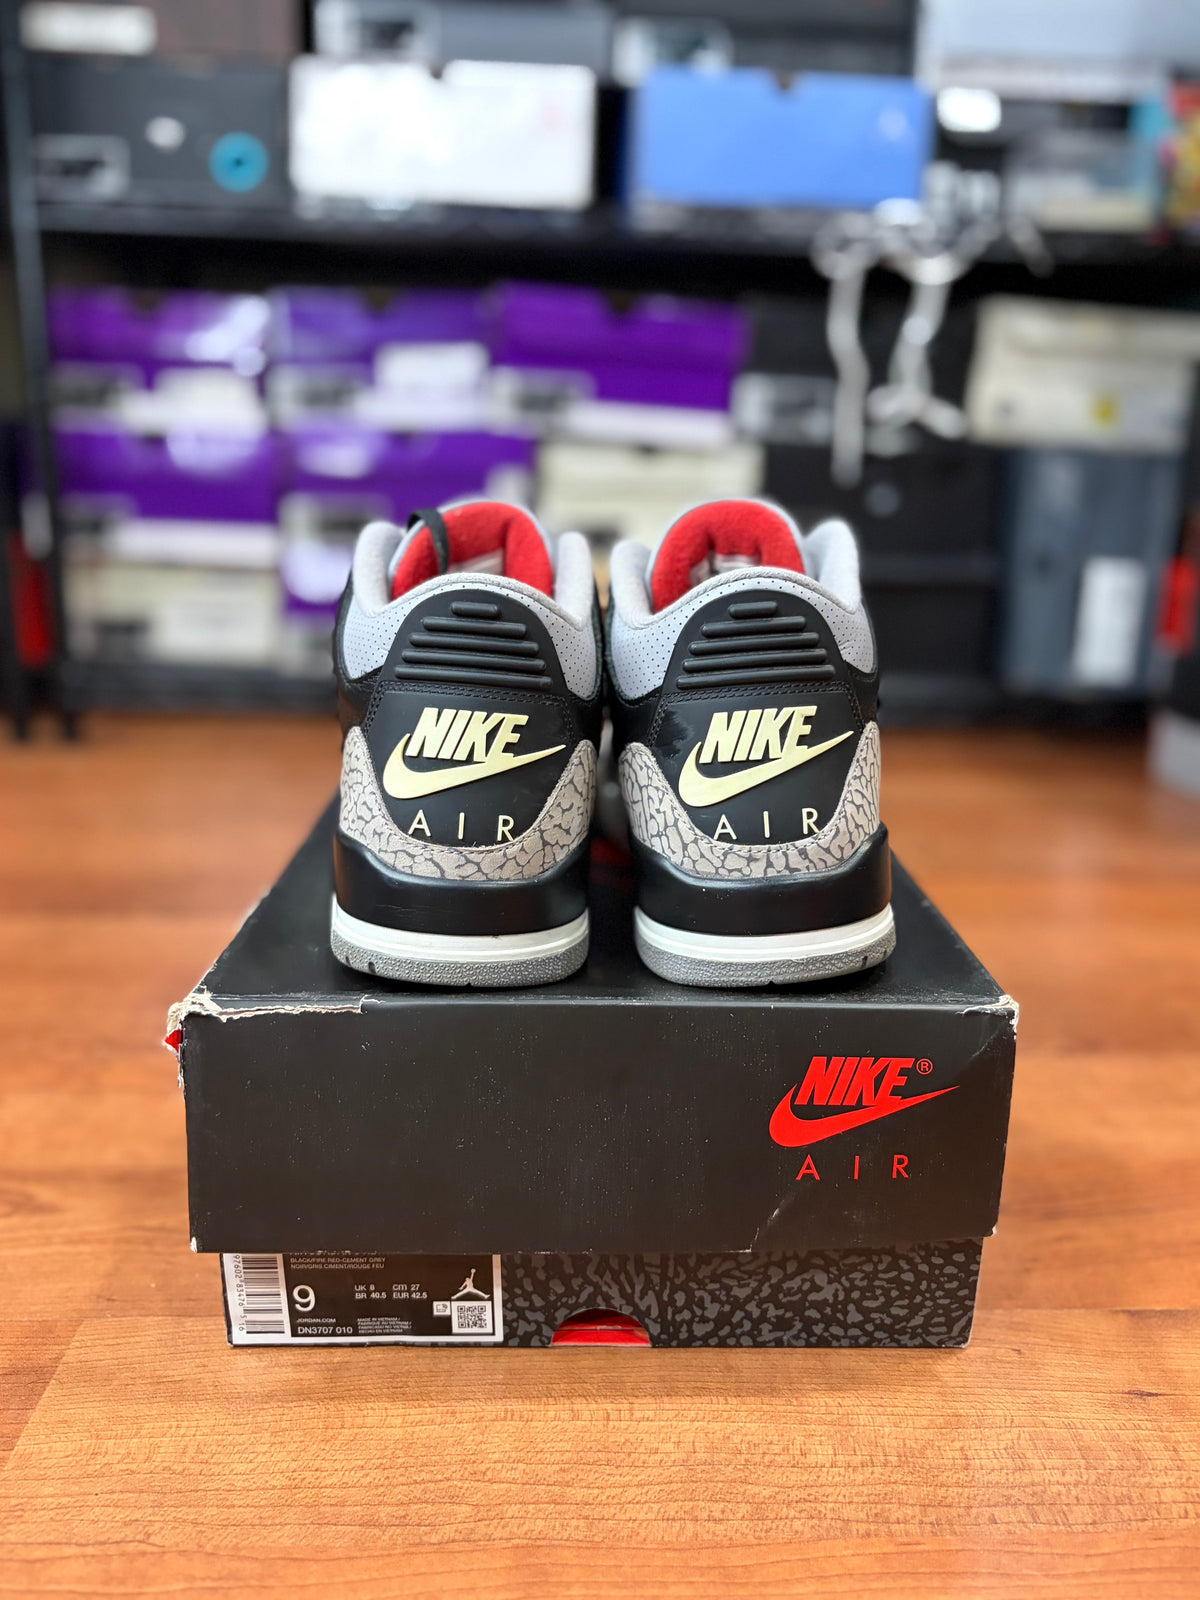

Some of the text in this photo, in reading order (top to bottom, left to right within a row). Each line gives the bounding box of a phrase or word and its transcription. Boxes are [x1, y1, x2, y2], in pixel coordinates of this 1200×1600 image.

[405, 707, 529, 762] NIKE
[699, 706, 817, 763] NIKE
[408, 809, 515, 841] AIR
[714, 807, 820, 840] AIR
[796, 1154, 909, 1180] AIR
[292, 1284, 316, 1312] 9
[297, 1326, 353, 1334] DN3707 010
